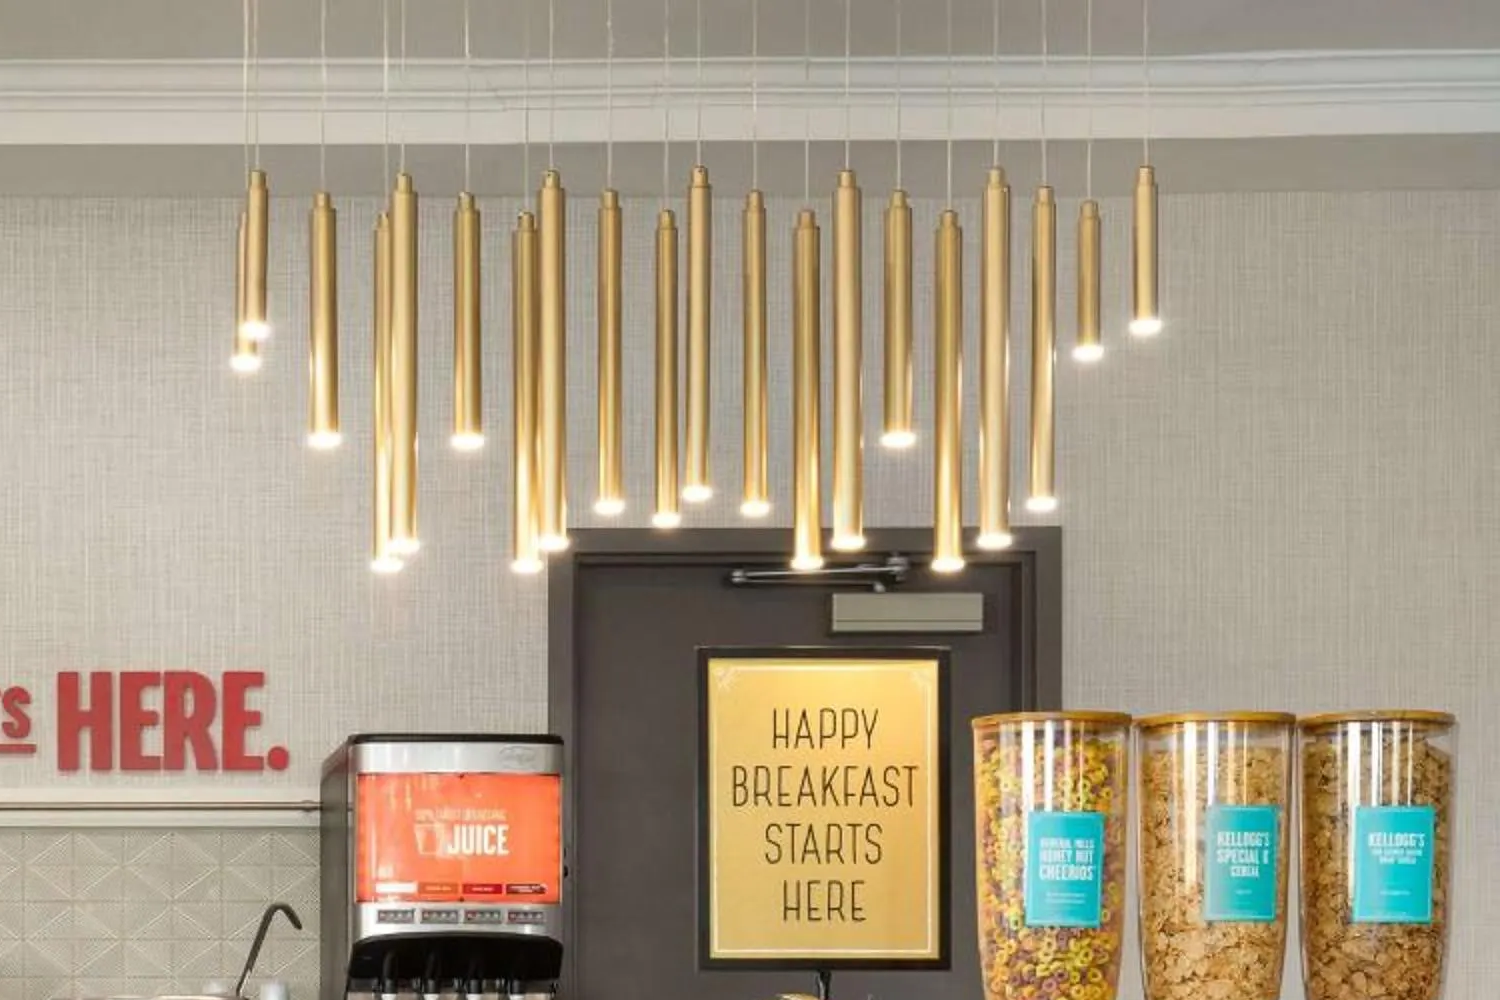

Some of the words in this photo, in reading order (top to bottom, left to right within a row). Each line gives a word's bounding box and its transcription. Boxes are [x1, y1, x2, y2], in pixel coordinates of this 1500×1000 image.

[56, 671, 289, 772] HERE.
[772, 707, 879, 750] HAPPY
[732, 764, 919, 808] BREAKFAST
[447, 824, 510, 856] JUICE
[764, 822, 883, 865] STARTS
[1216, 849, 1260, 865] SPECIAL
[1217, 831, 1269, 848] KELLOGG'S
[1368, 831, 1425, 848] KELLOGG'S
[1039, 864, 1095, 881] CHEERIOS
[783, 878, 867, 922] HERE
